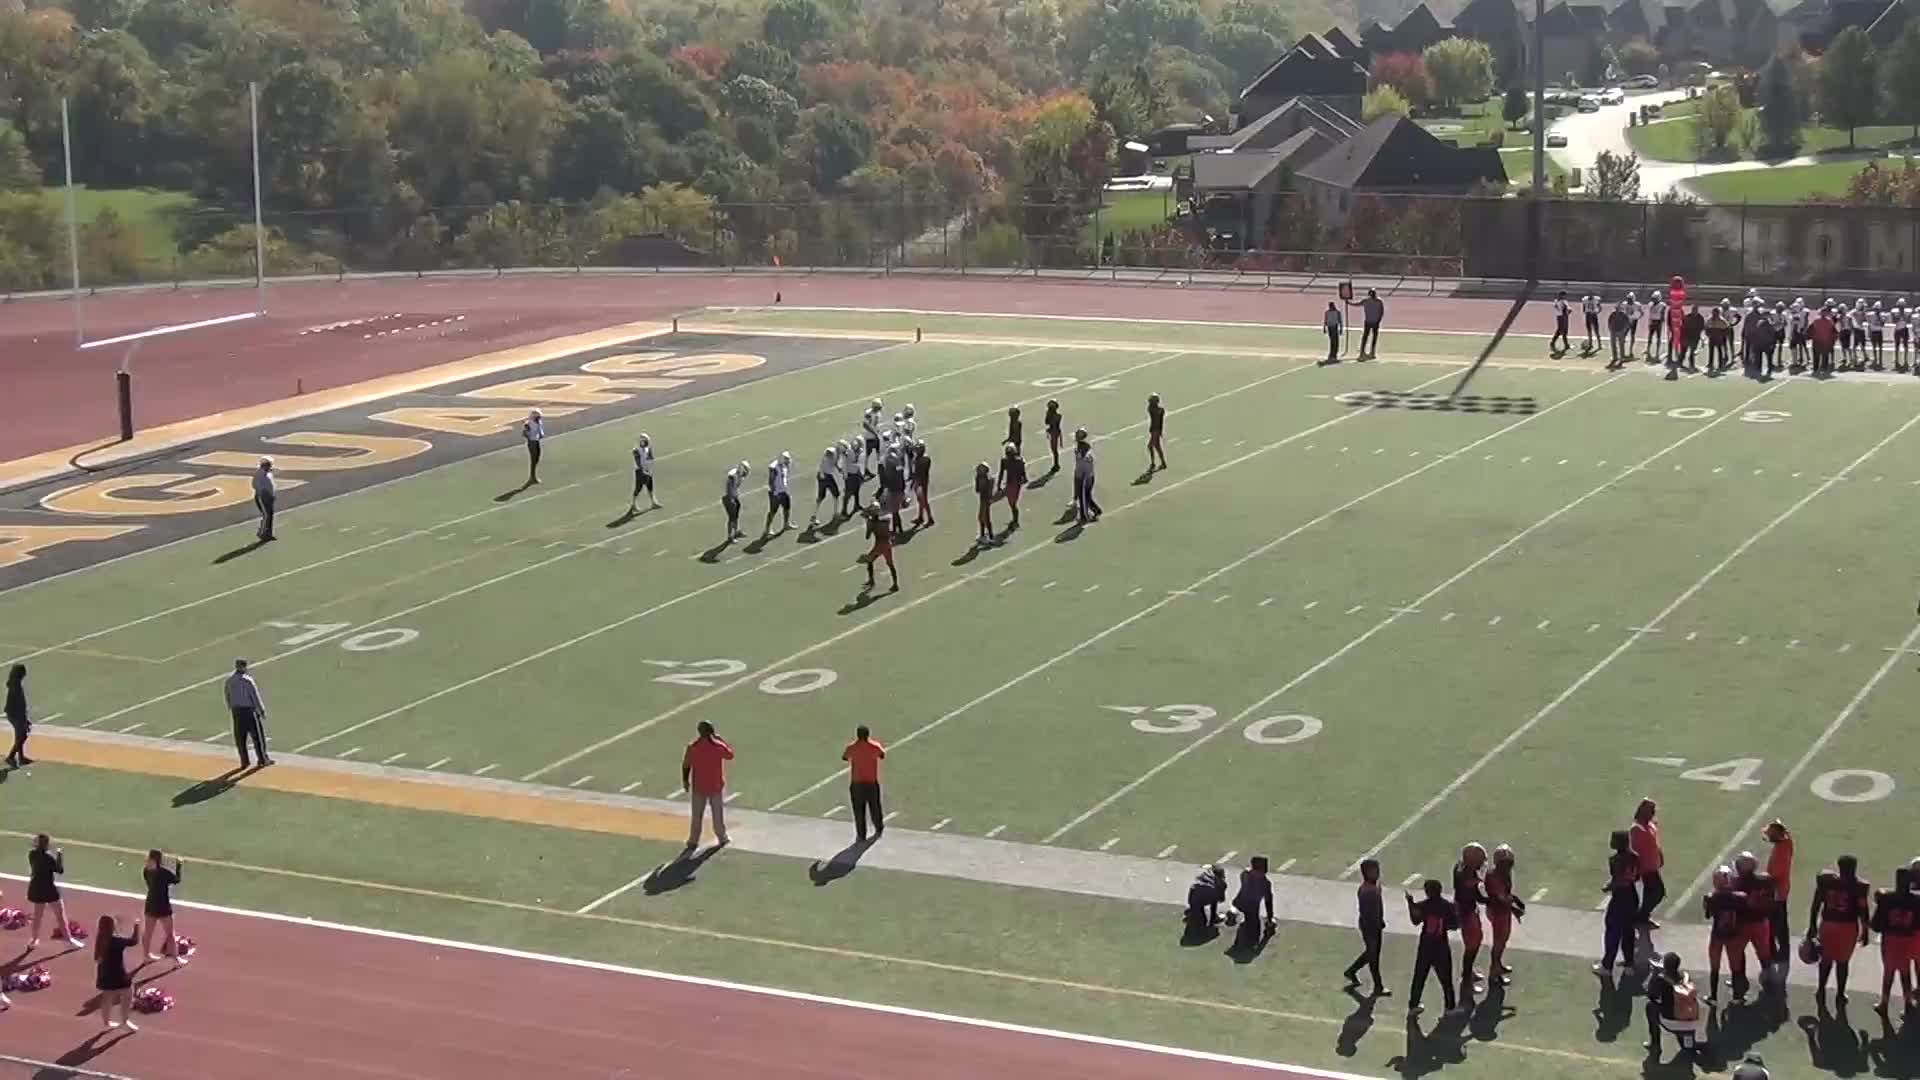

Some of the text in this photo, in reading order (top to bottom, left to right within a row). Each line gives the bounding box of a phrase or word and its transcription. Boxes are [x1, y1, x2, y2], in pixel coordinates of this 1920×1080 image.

[654, 658, 838, 695] 20
[1130, 703, 1323, 744] 30
[1680, 757, 1896, 802] 40
